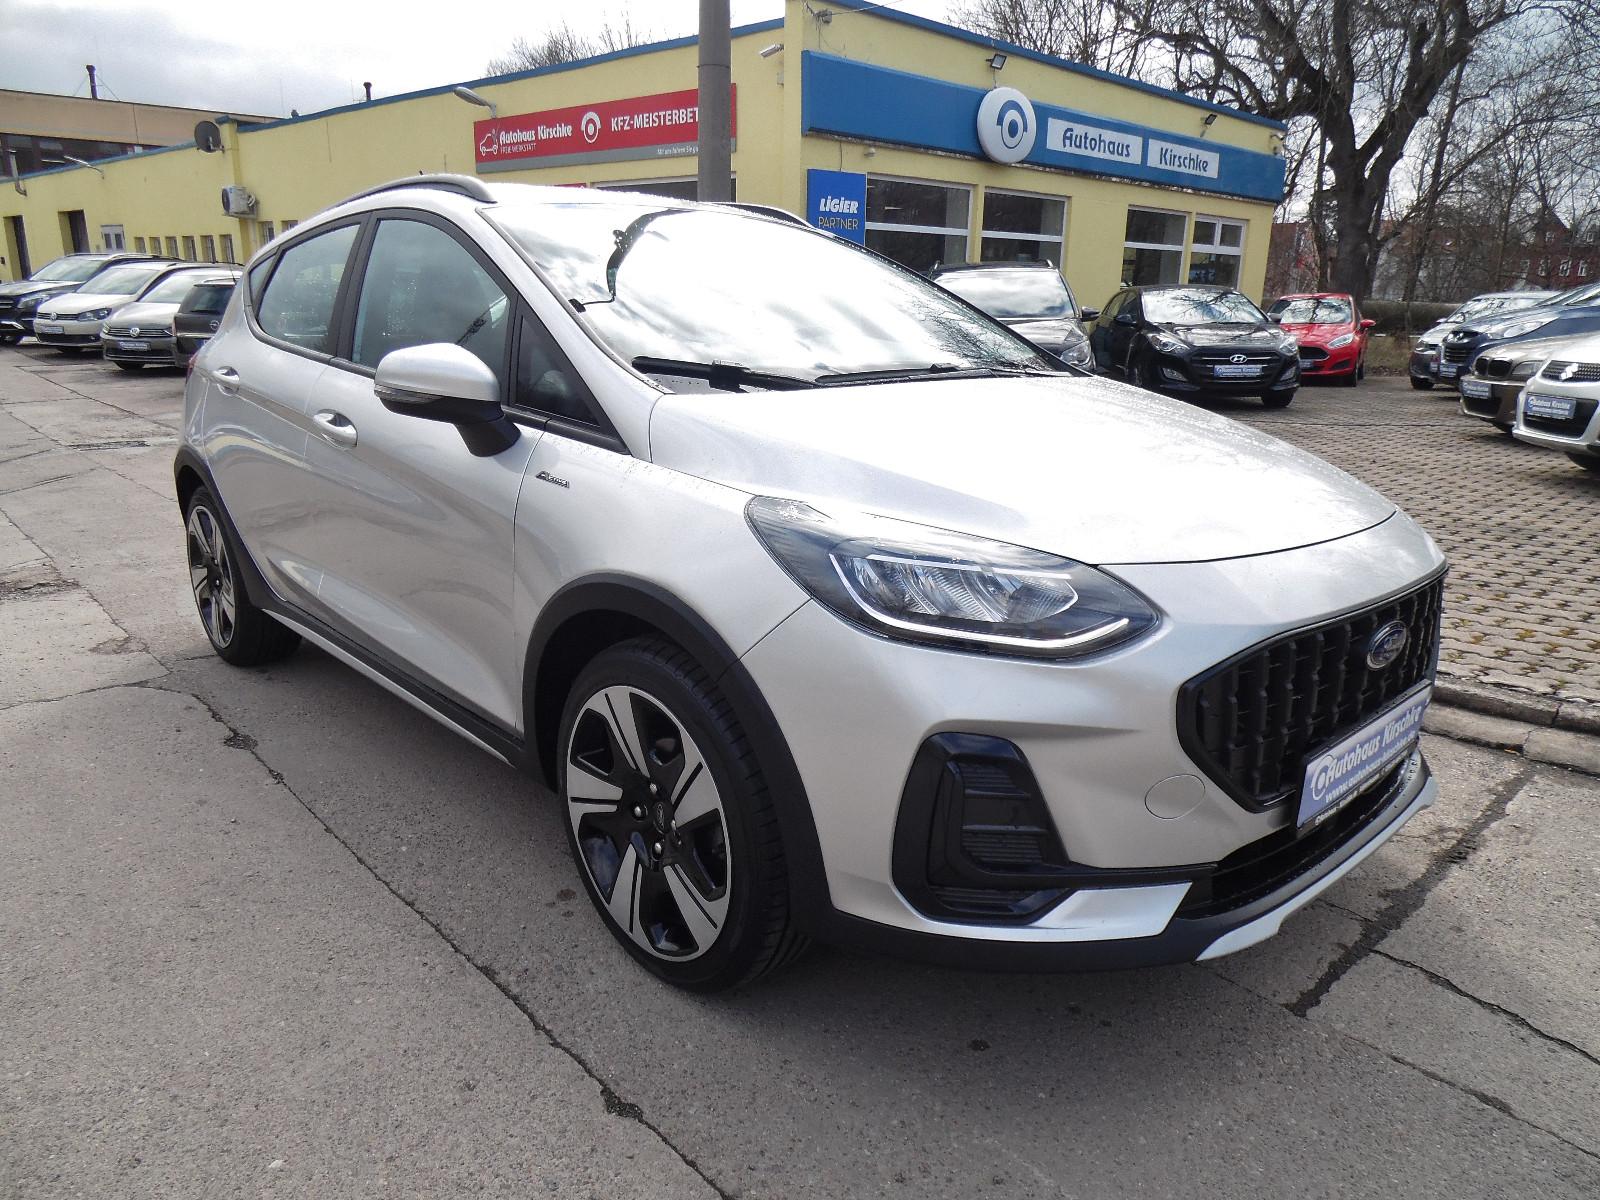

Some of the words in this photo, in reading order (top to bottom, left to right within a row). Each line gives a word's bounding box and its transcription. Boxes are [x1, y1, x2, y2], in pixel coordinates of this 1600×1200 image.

[611, 106, 699, 132] KFZ-MEISTERBET
[500, 129, 536, 146] Autohaus
[537, 122, 573, 140] Kirschke
[1062, 127, 1131, 158] Autohaus
[1159, 147, 1209, 173] Kirschke
[818, 216, 859, 230] PARTNER
[1325, 735, 1381, 787] Autohaus
[1382, 705, 1422, 747] Kirschke
